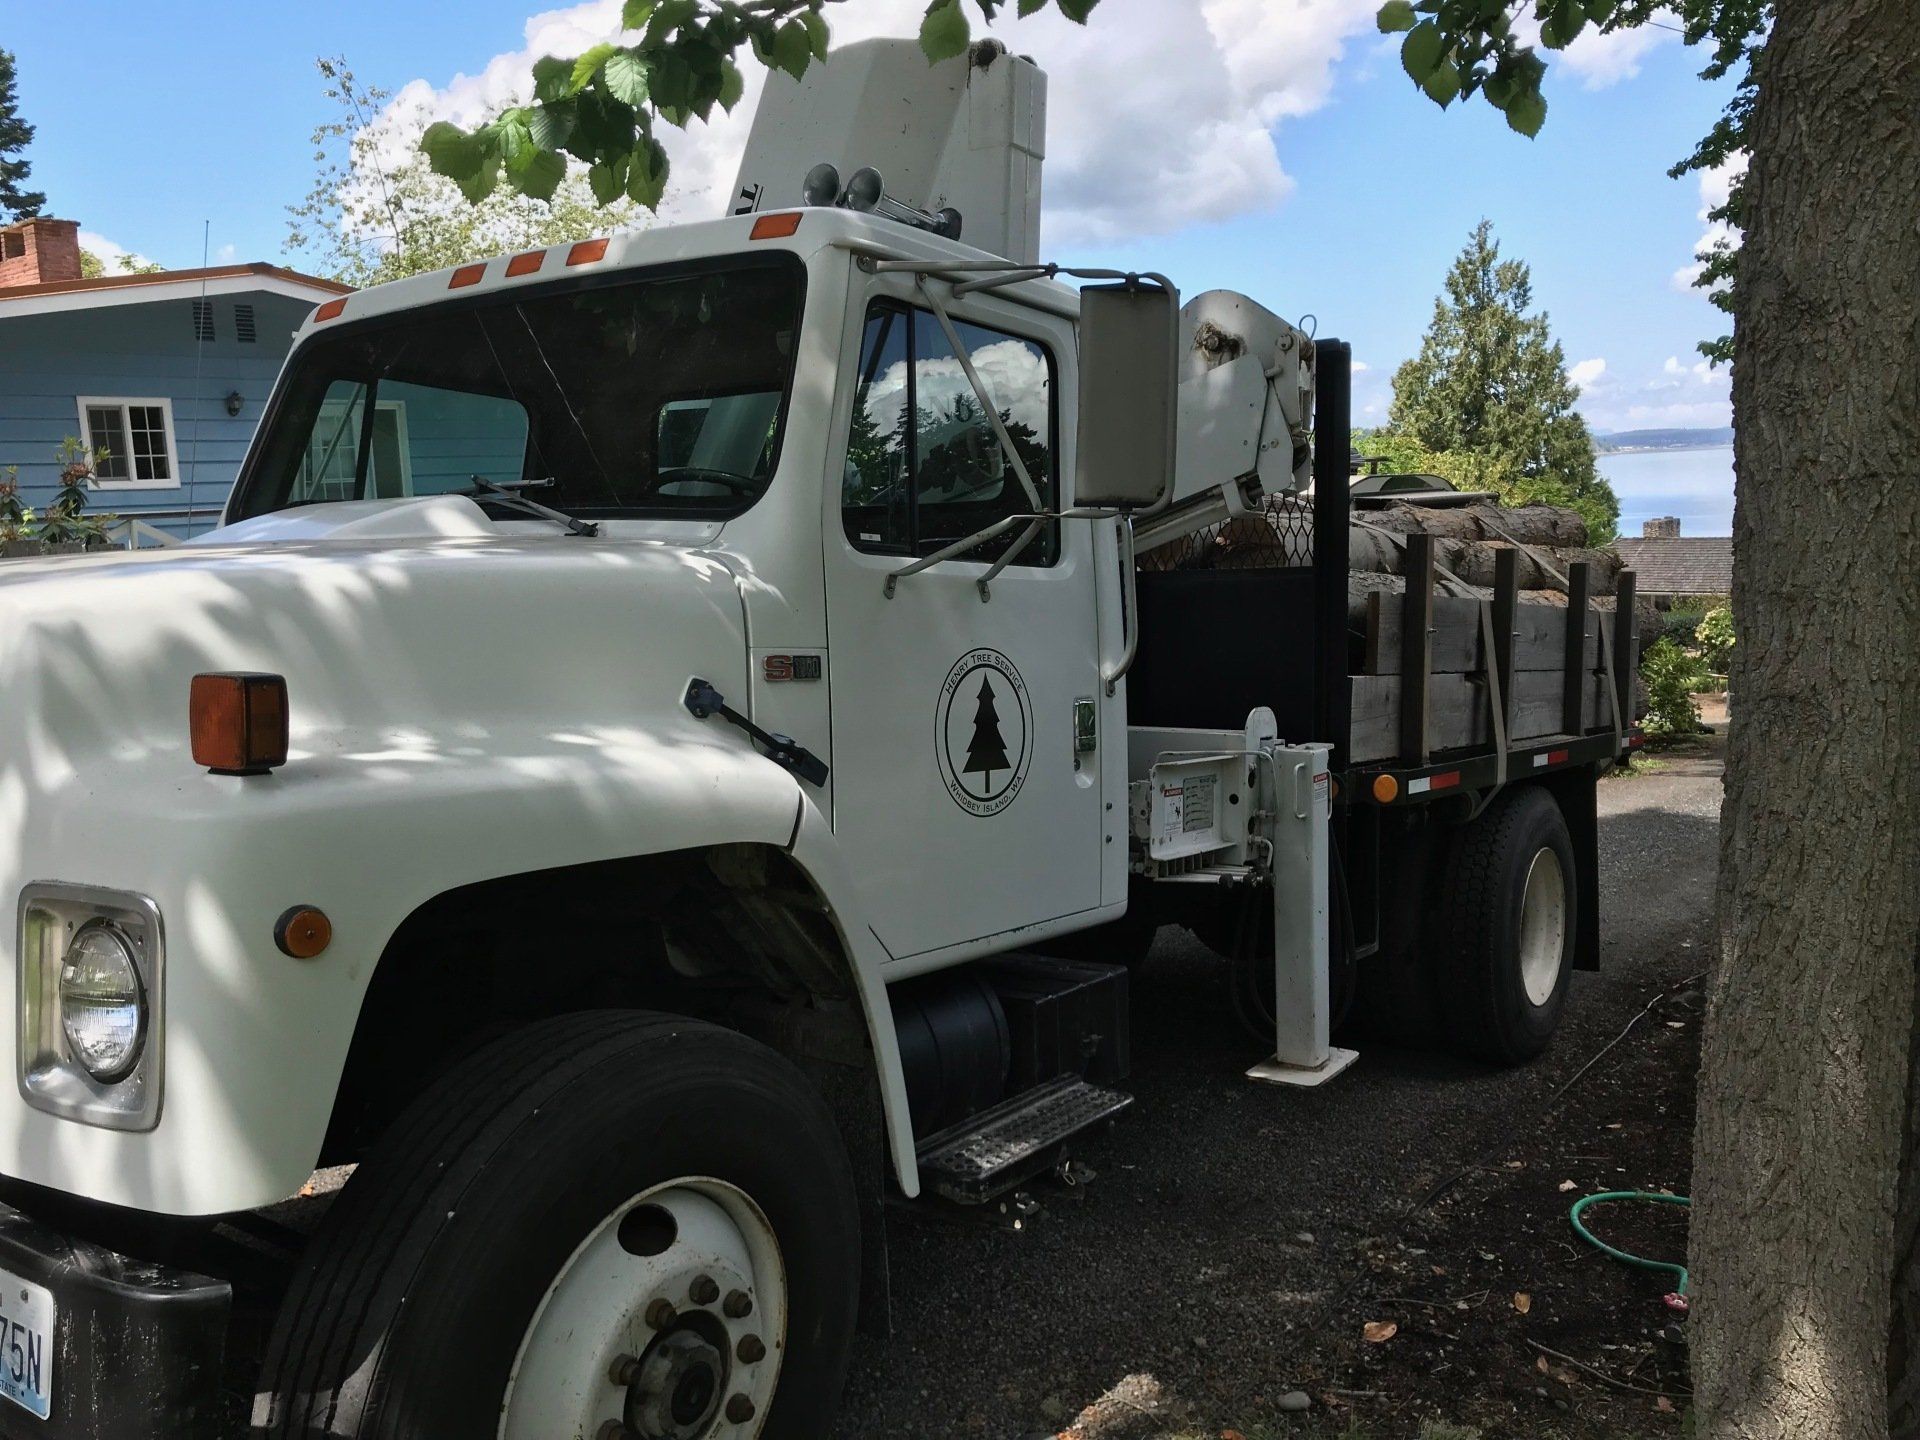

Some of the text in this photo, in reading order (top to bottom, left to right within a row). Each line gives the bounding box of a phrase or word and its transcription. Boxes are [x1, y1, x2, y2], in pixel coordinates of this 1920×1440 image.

[945, 653, 1023, 695] HENRY TREE SERVICE
[950, 779, 980, 812] WHIDBEY
[1010, 776, 1022, 792] WA
[0, 1315, 42, 1395] 75N
